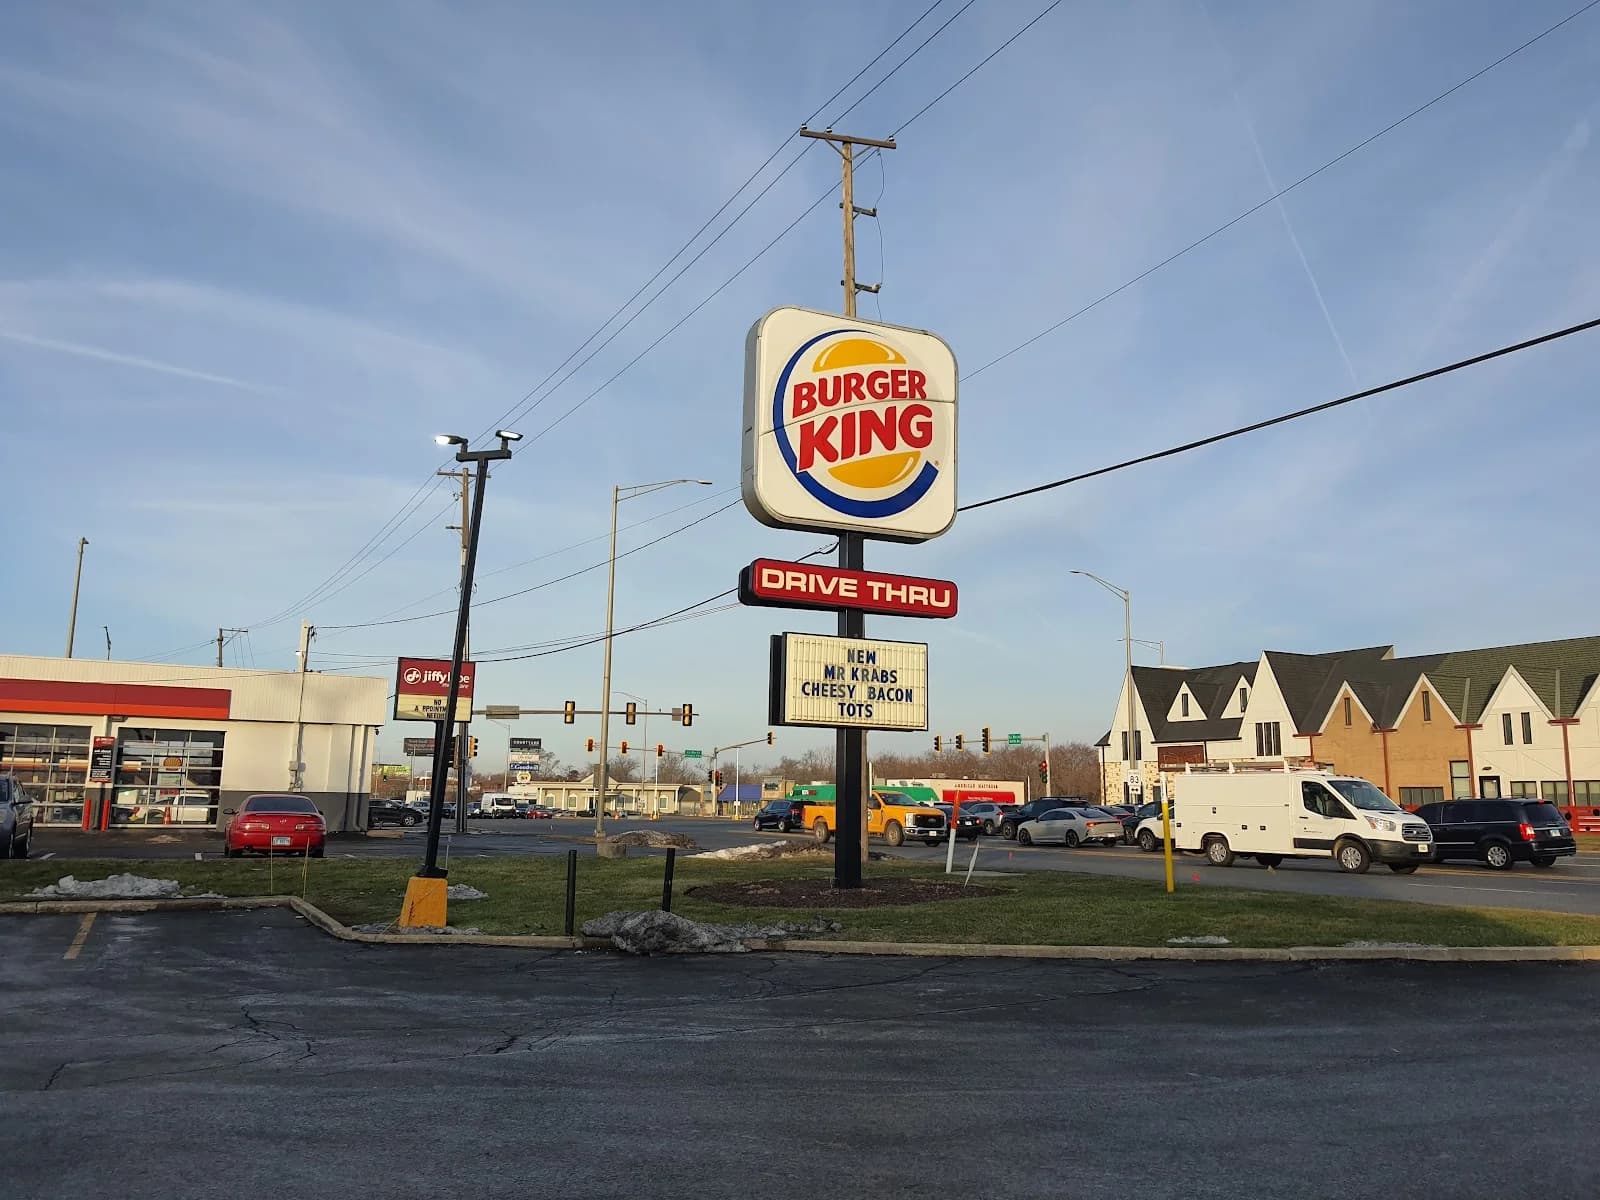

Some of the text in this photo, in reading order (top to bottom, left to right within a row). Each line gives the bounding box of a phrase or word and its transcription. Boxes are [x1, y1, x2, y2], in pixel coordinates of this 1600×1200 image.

[793, 369, 927, 418] BURGER
[798, 404, 933, 471] KING
[761, 568, 950, 608] DRIVE THRU
[847, 648, 876, 665] NEW
[422, 670, 470, 684] jiffy le
[824, 665, 898, 684] MR KRABS
[801, 681, 913, 703] CHEESY BACON
[838, 702, 873, 718] TOTS
